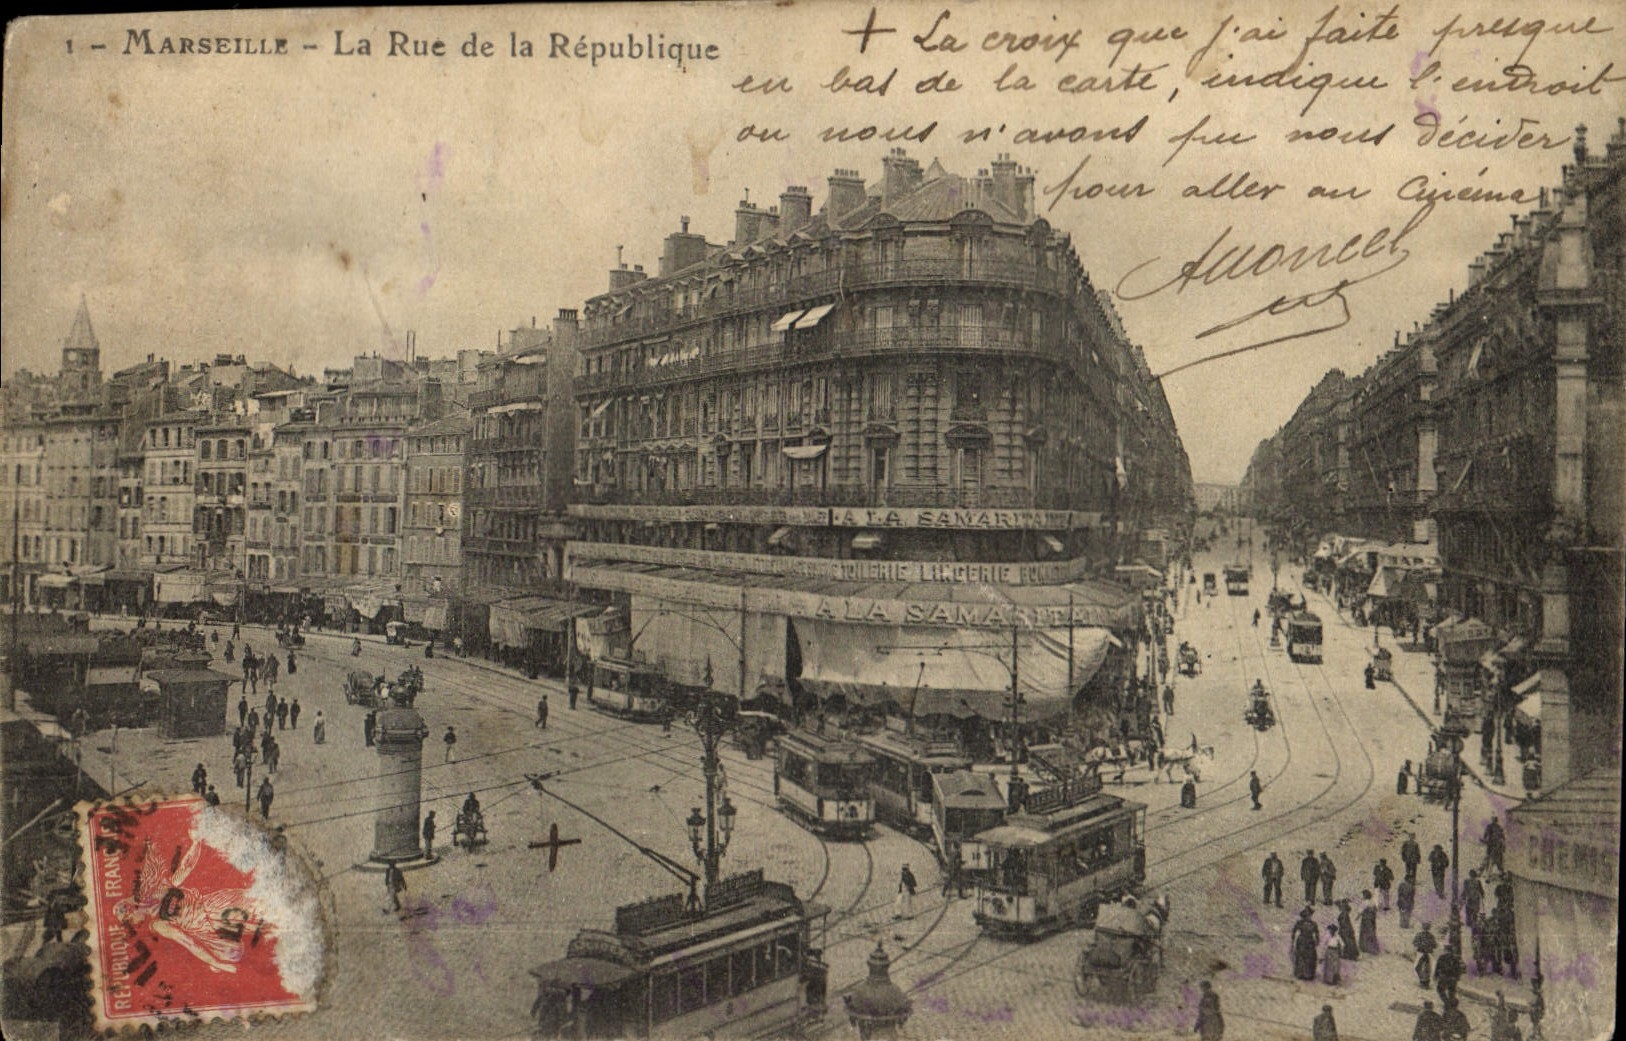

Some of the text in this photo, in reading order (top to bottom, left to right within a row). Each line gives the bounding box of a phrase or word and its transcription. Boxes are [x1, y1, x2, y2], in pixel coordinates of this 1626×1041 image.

[913, 10, 968, 53] La
[981, 14, 1082, 63] croix
[1106, 27, 1188, 69] que
[1428, 13, 1614, 67] presque
[731, 73, 794, 95] en
[819, 66, 899, 97] bas
[914, 69, 963, 94] de
[993, 63, 1037, 92] la
[1200, 53, 1389, 118] indique
[818, 121, 939, 144] nous
[1161, 114, 1257, 169] pu
[1285, 122, 1397, 147] nous
[1413, 111, 1573, 150] décider
[1042, 154, 1157, 212] pour
[1181, 171, 1286, 201] aller
[1307, 178, 1373, 200] au
[866, 509, 905, 527] LA
[919, 563, 1011, 584] LINGERIE
[815, 598, 836, 620] A
[844, 599, 892, 623] LA
